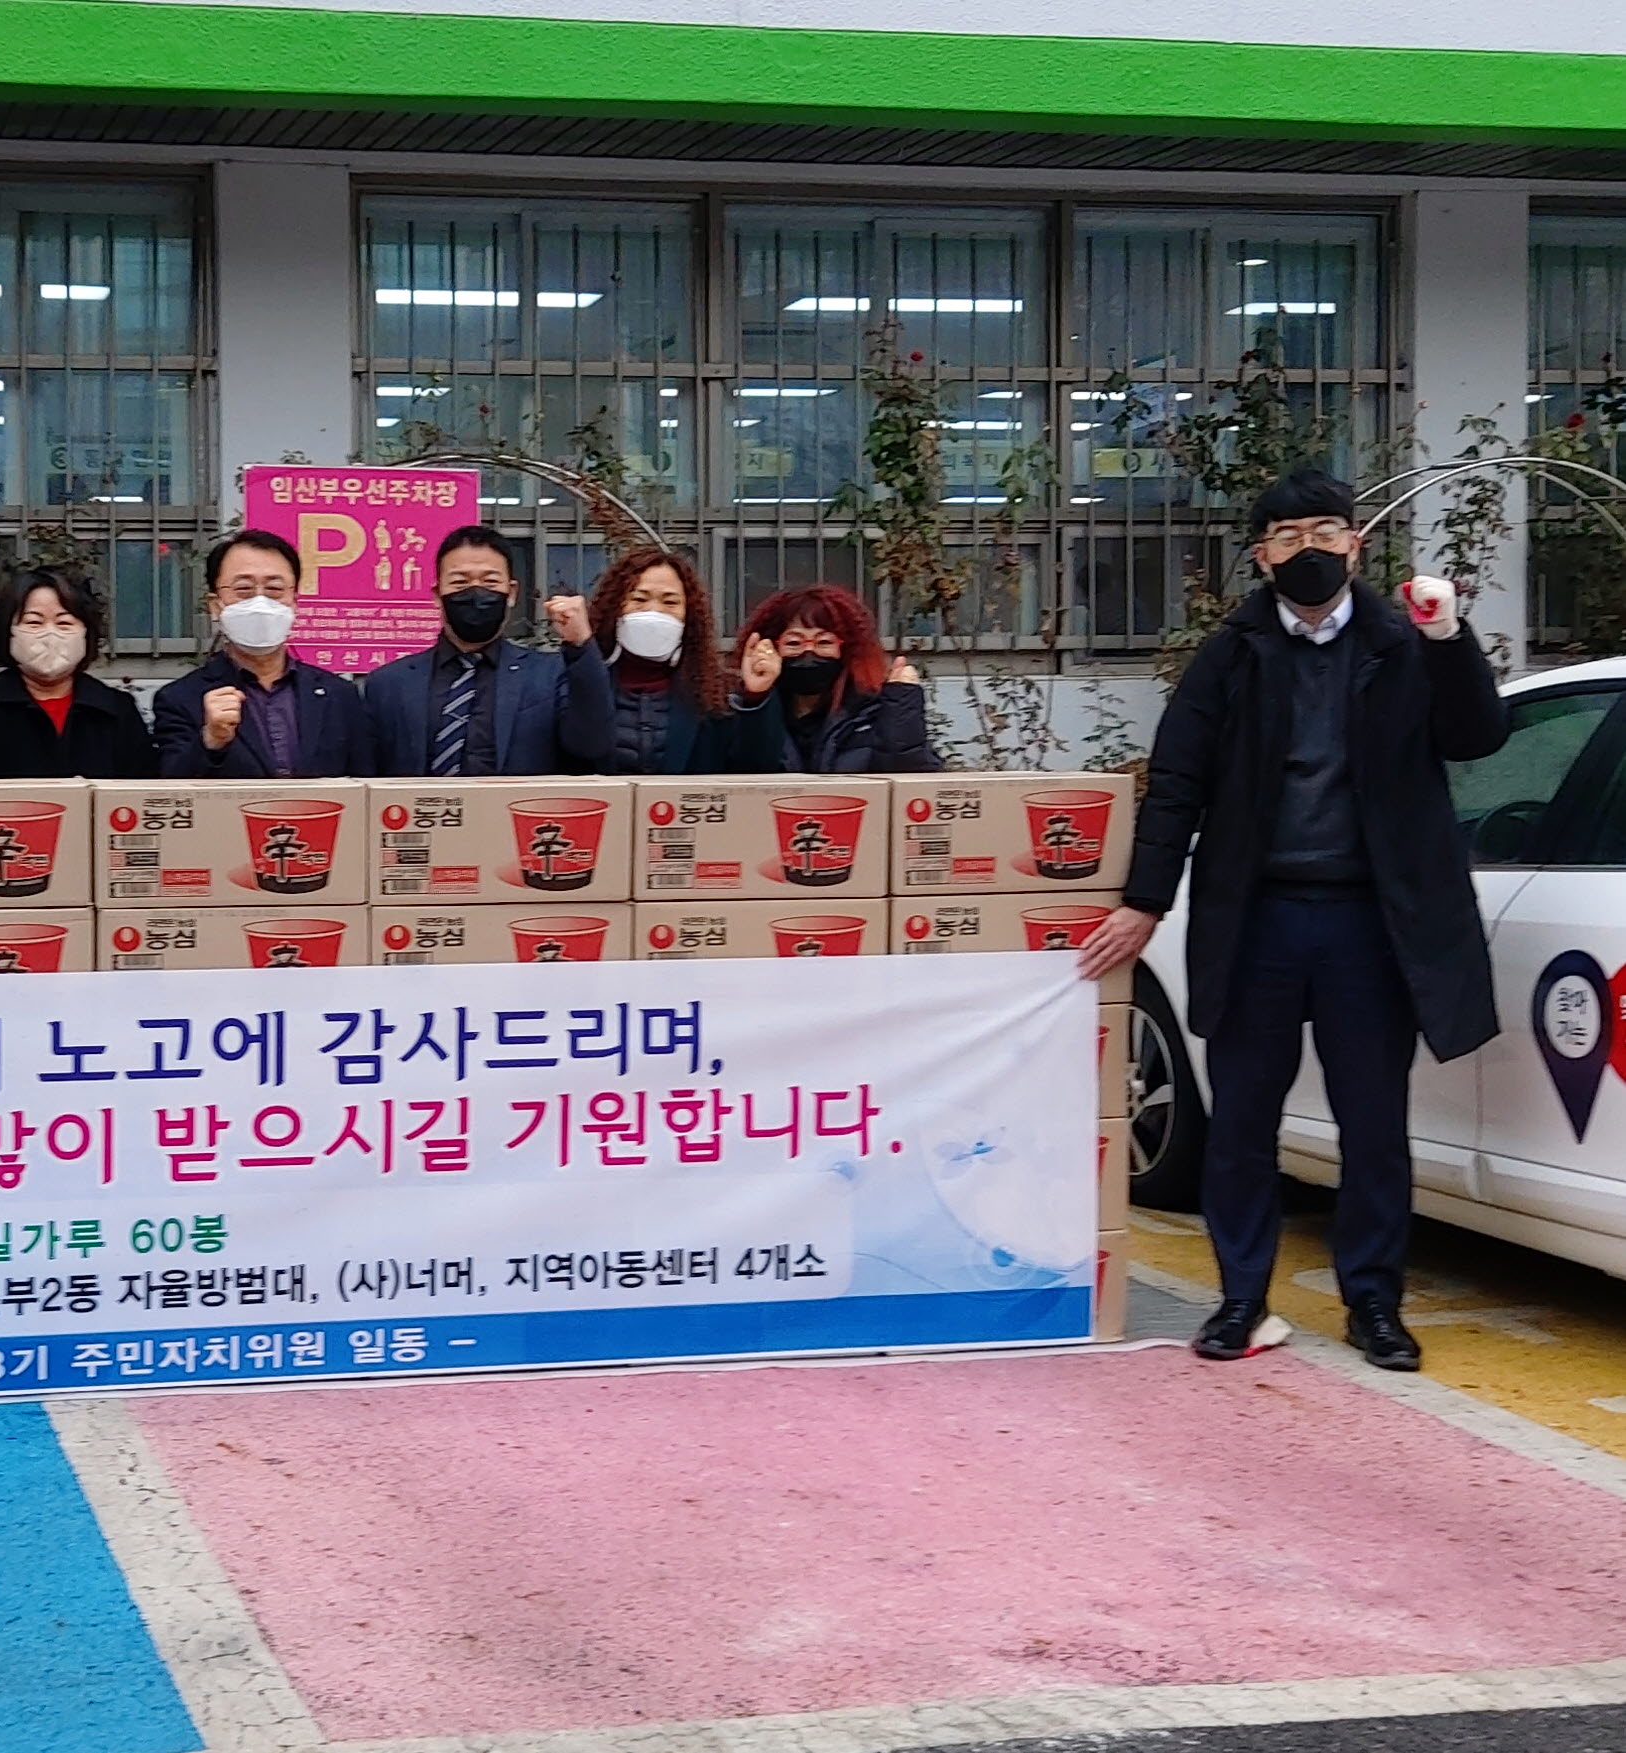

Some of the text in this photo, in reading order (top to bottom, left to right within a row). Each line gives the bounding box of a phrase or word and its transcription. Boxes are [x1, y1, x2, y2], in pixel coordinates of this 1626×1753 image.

[270, 477, 458, 507] 임산부우선주차장
[298, 512, 368, 596] P
[141, 809, 194, 830] 농심
[412, 807, 463, 828] 농심
[679, 804, 727, 824] 농심
[935, 800, 982, 820] 농심
[415, 927, 466, 948] 농심
[679, 927, 727, 947] 농심
[934, 917, 980, 937] 농심
[145, 929, 197, 950] 농심
[38, 1010, 285, 1086] 노고에
[319, 1000, 722, 1085] 감사드리며,
[1555, 1020, 1589, 1046] 가는
[156, 1096, 470, 1182] 받으시길
[507, 1083, 903, 1168] 기원합니다.
[131, 1214, 228, 1254] 60봉
[118, 1263, 319, 1308] 자율방범대,
[338, 1257, 488, 1301] (사)너머,
[505, 1247, 719, 1291] 지역아동센터
[734, 1243, 828, 1281] 4개소
[70, 1330, 326, 1379] 주민자치위원
[348, 1326, 429, 1364] 일동
